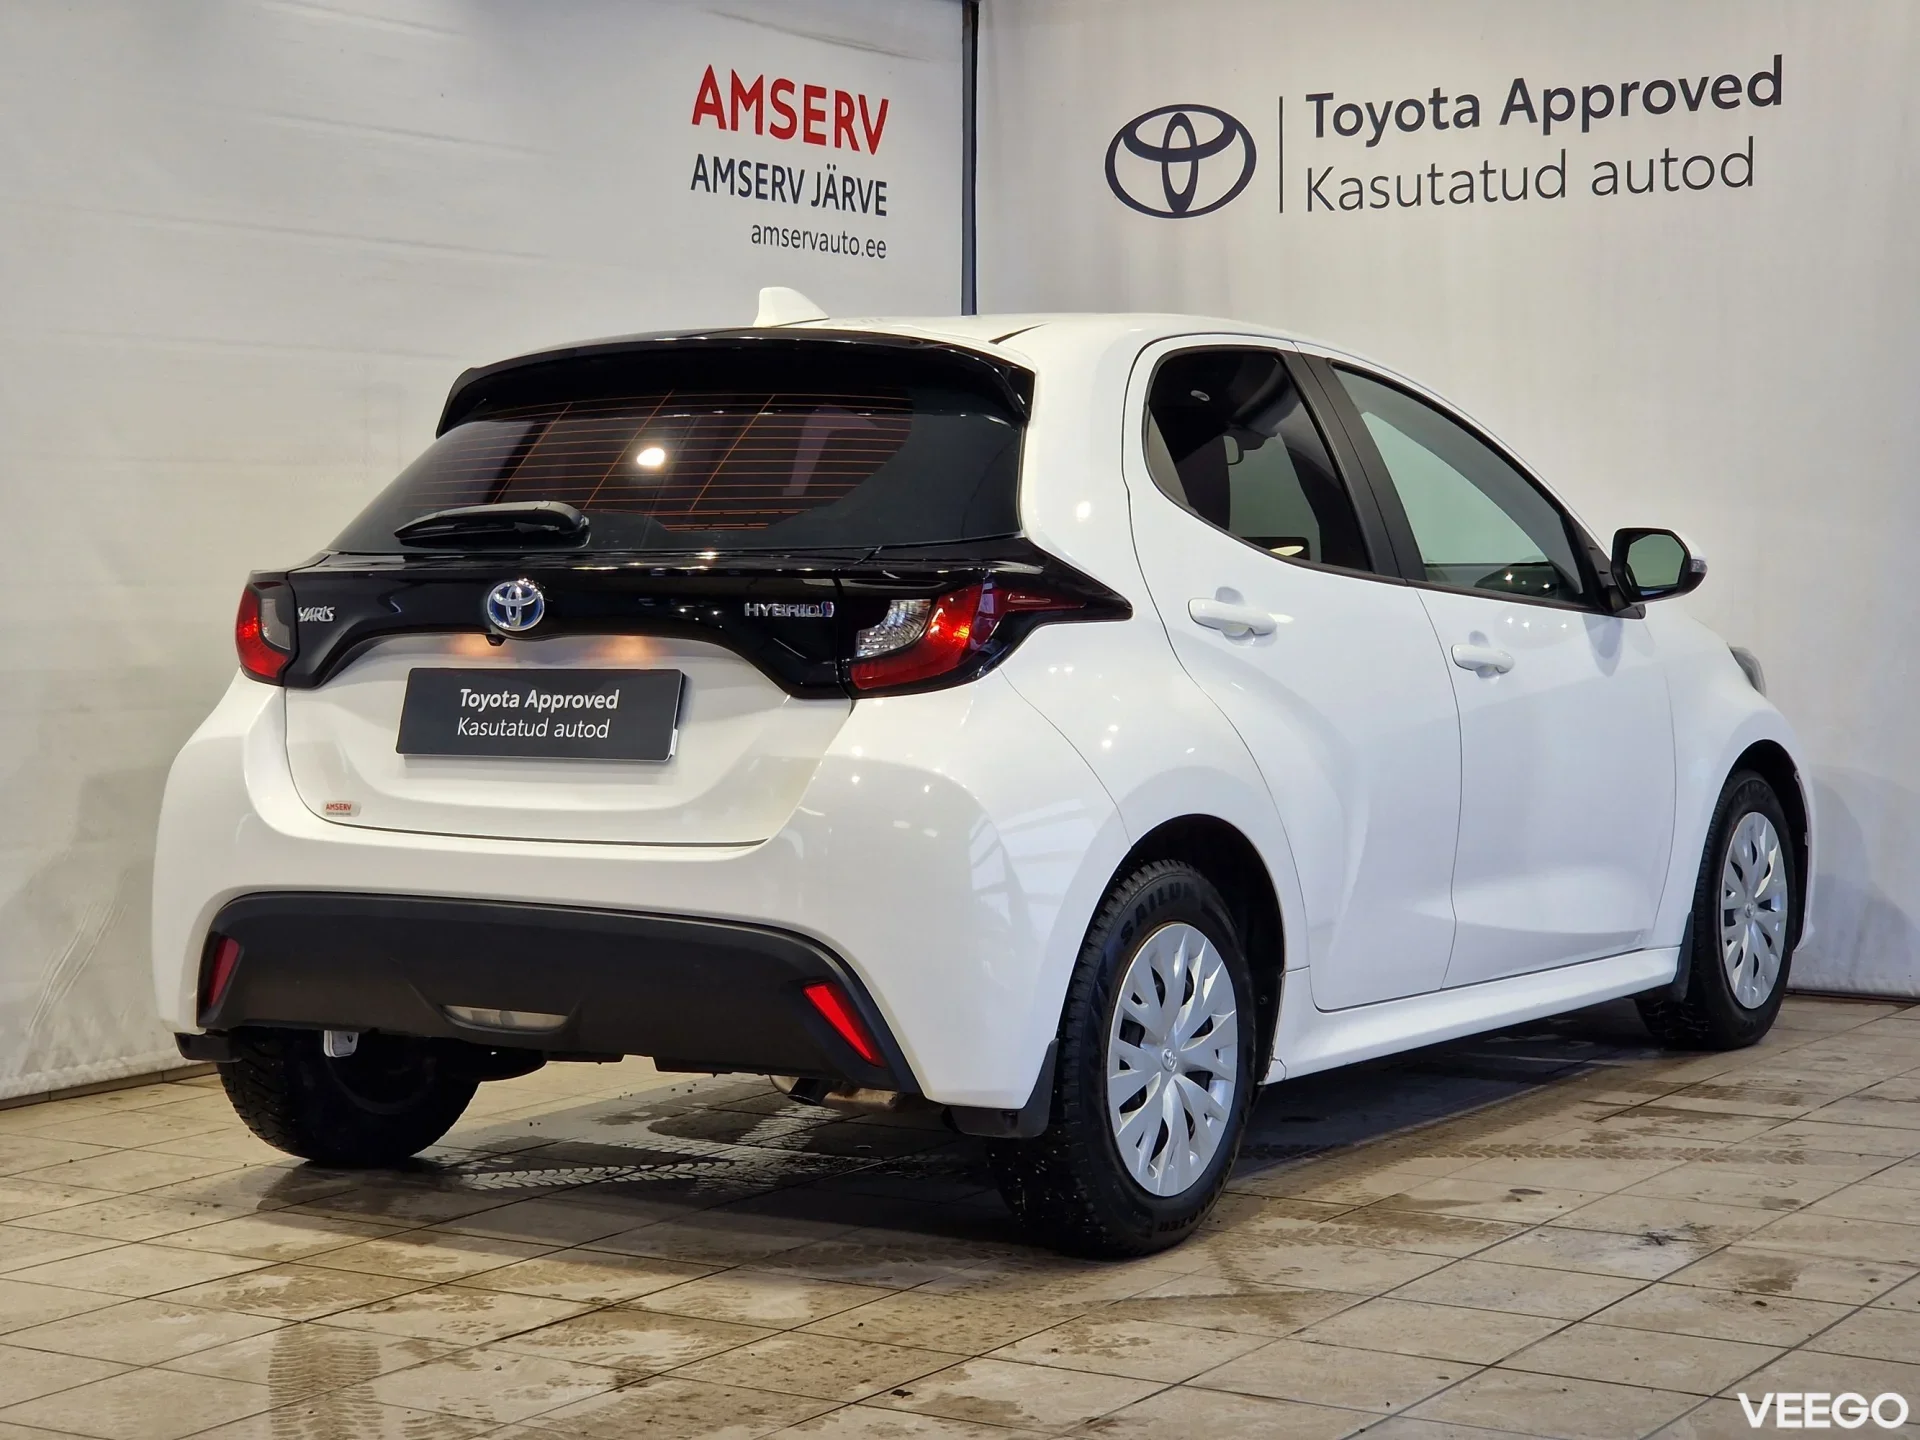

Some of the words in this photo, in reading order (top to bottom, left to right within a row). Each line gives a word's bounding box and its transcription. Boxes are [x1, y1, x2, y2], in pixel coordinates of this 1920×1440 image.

[691, 64, 889, 155] AMSERV
[1305, 87, 1480, 148] Toyota
[1499, 54, 1782, 137] Approved
[690, 153, 805, 205] AMSERV
[810, 163, 888, 217] JÄRVE
[1307, 149, 1566, 212] Kasutatud
[1591, 136, 1754, 197] autod
[751, 224, 887, 260] amservauto.ee
[298, 605, 336, 622] YARIS
[744, 602, 820, 617] HYBRID
[459, 688, 520, 712] Toyota
[524, 688, 620, 713] Approved
[457, 716, 549, 738] Kasutatud
[553, 718, 610, 739] autod
[325, 803, 352, 811] AMSERV
